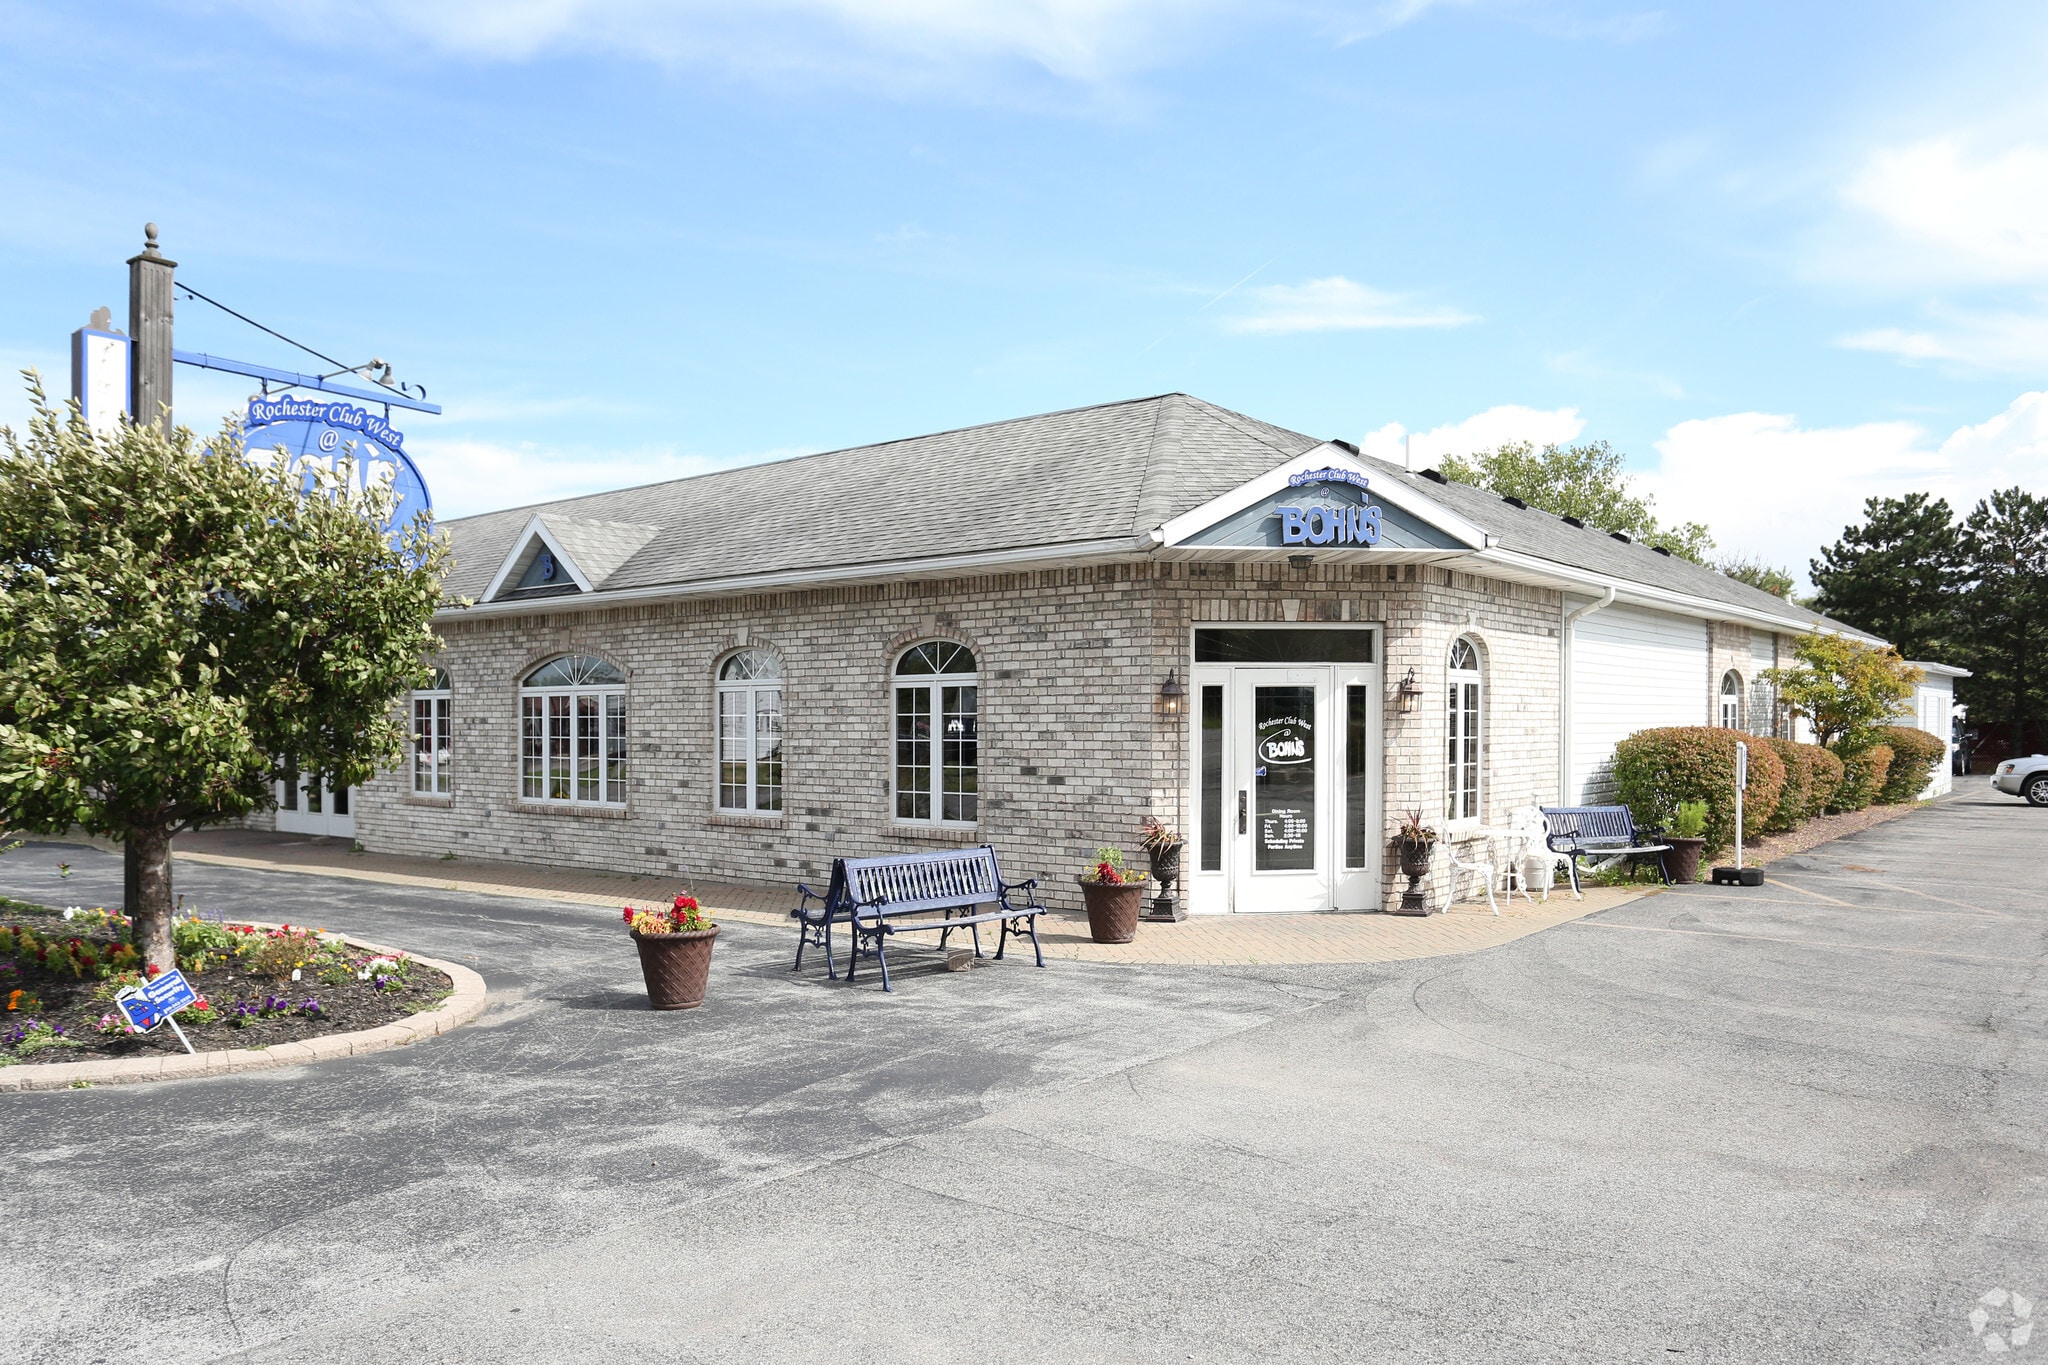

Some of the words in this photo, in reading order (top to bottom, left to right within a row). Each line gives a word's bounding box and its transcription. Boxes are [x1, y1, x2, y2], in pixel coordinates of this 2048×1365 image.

[252, 399, 327, 421] Rochester
[329, 405, 362, 426] Club
[366, 418, 401, 446] West
[319, 429, 339, 452] @
[1290, 470, 1327, 485] Rochester
[1328, 469, 1346, 479] Club
[1347, 473, 1369, 486] West
[1320, 486, 1330, 497] @
[1273, 492, 1383, 545] BOHN'S
[541, 554, 554, 580] B
[1284, 716, 1297, 725] Club
[147, 975, 182, 998] General
[154, 984, 185, 1004] Security
